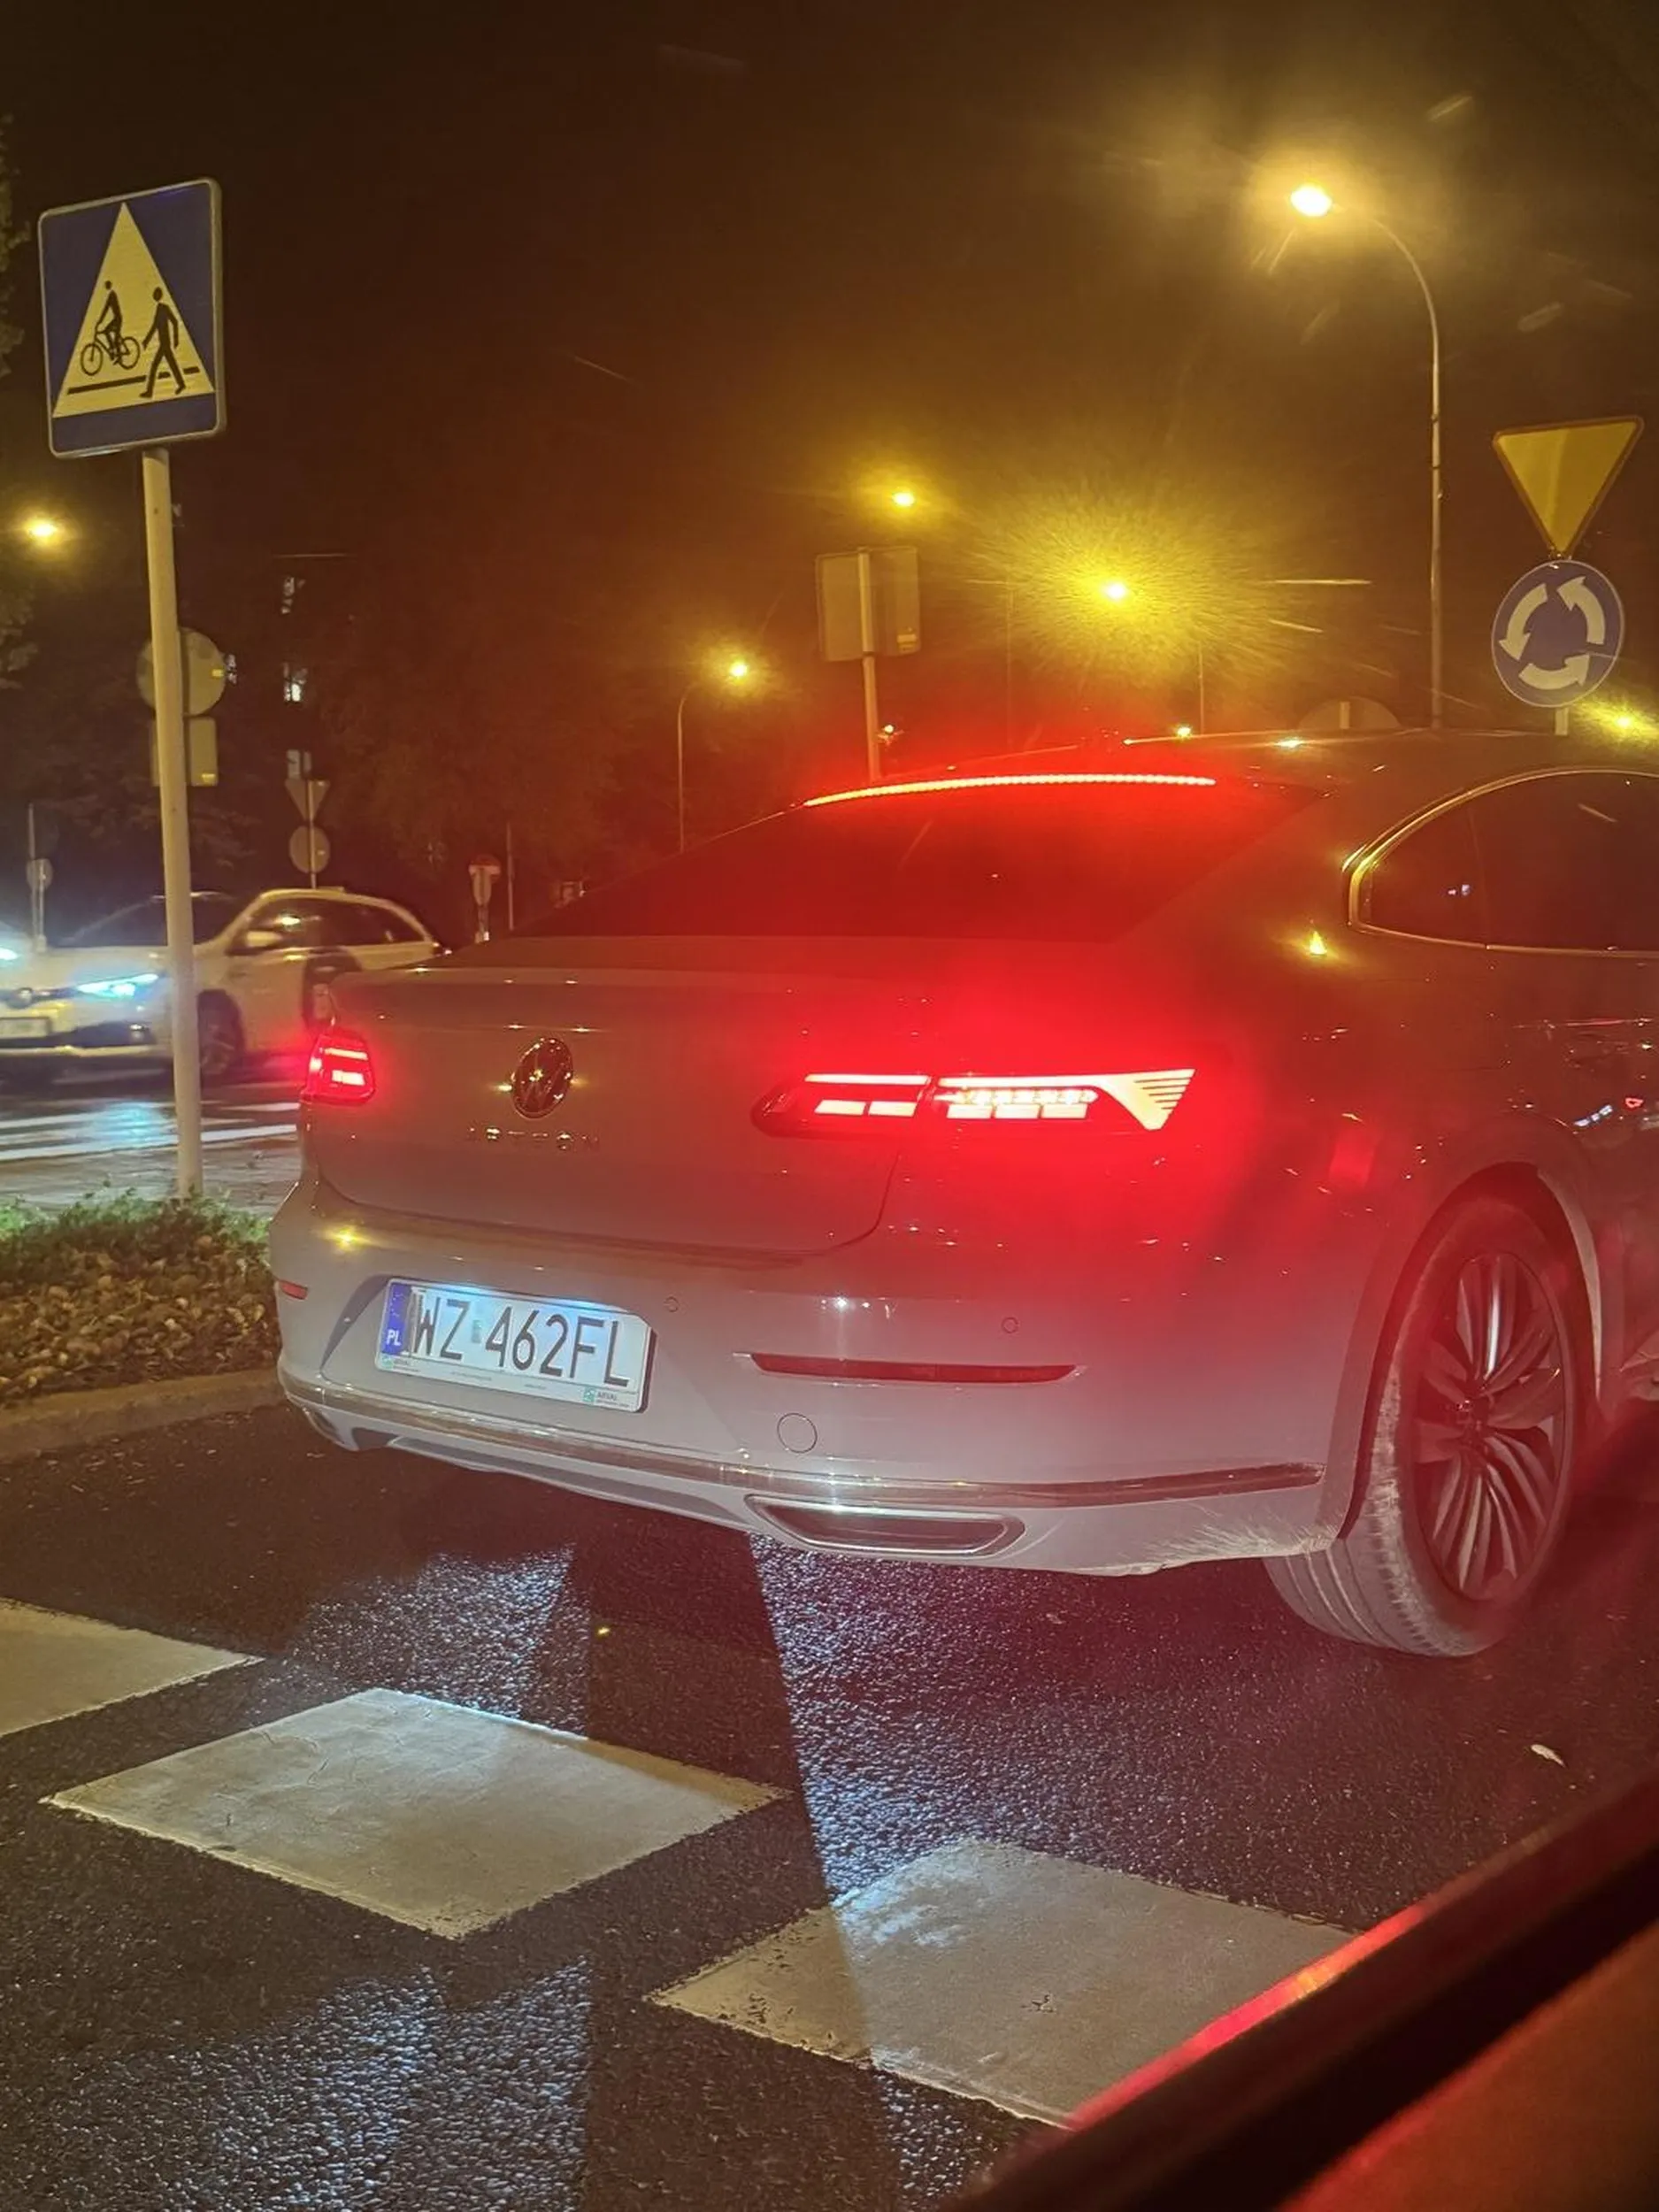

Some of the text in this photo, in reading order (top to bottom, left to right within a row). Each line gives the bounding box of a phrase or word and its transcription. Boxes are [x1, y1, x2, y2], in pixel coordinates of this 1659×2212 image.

[386, 1329, 402, 1346] PL
[413, 1294, 630, 1387] WZ 462FL
